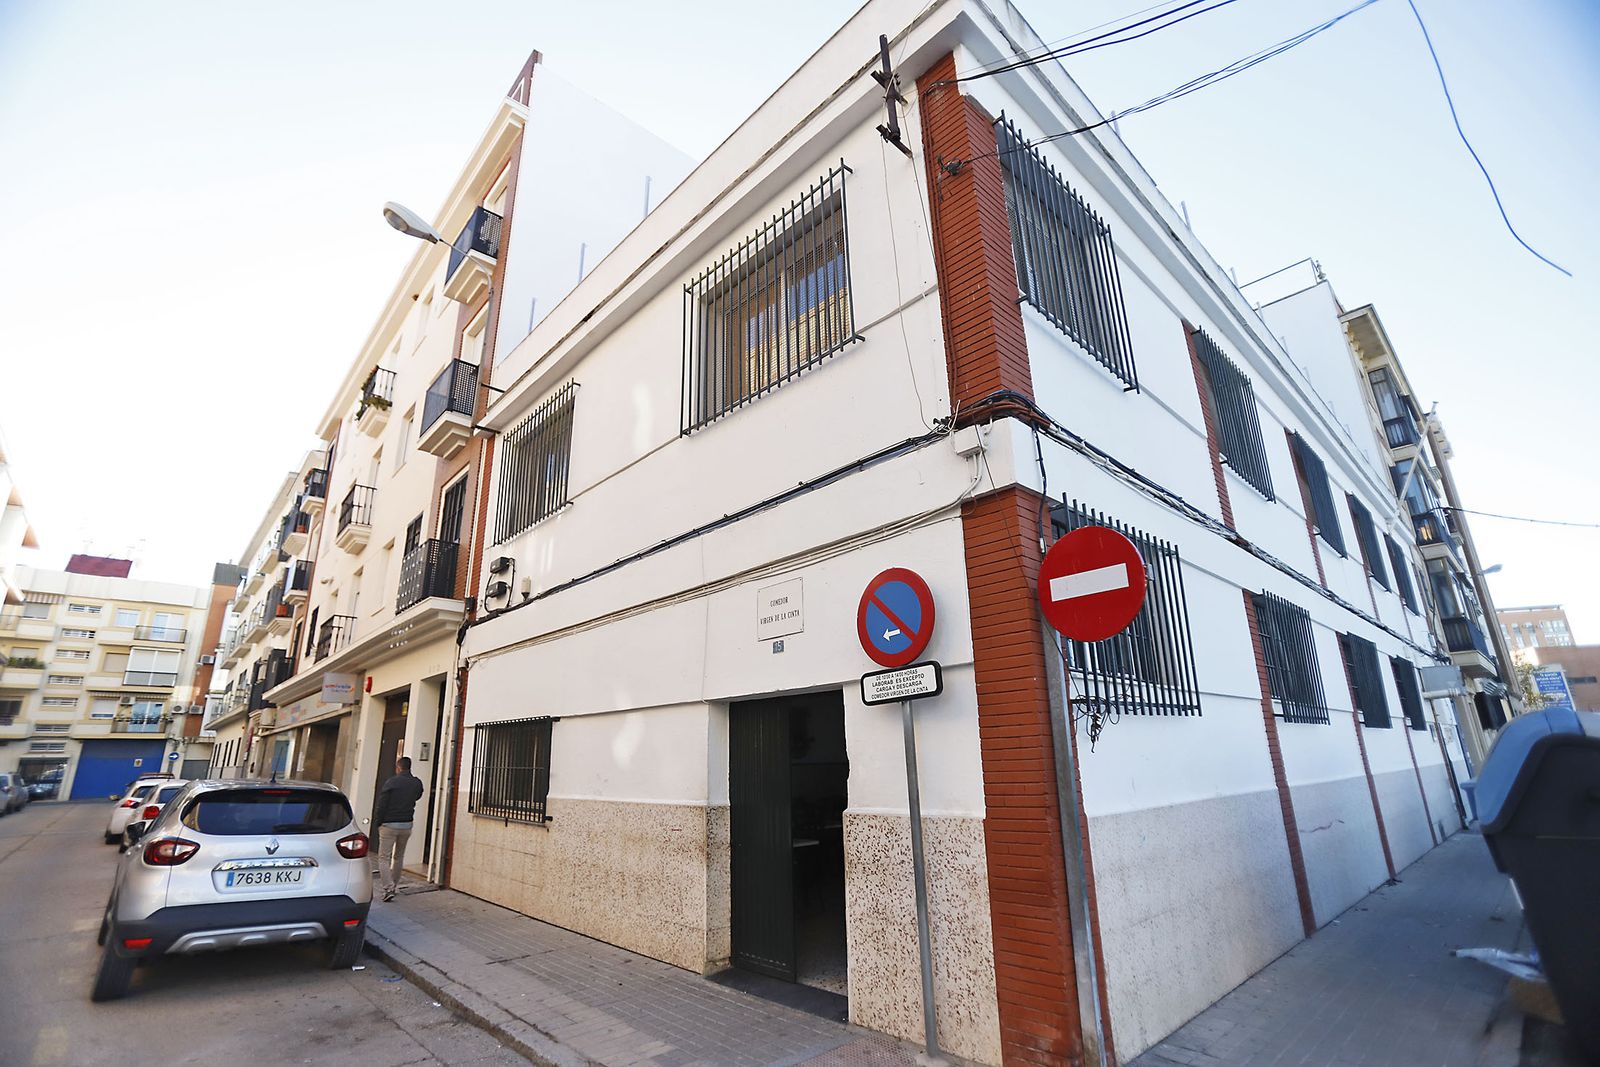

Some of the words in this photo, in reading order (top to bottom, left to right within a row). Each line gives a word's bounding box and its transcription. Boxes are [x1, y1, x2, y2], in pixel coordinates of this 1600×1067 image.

[770, 596, 788, 607] COMEDOR
[760, 616, 774, 624] VIRGEN
[788, 609, 800, 618] CINTA
[774, 642, 782, 652] 15
[903, 673, 924, 682] EXCEPTO
[896, 681, 922, 690] DESCARGA
[236, 872, 272, 885] 7638
[276, 871, 302, 883] KKJ
